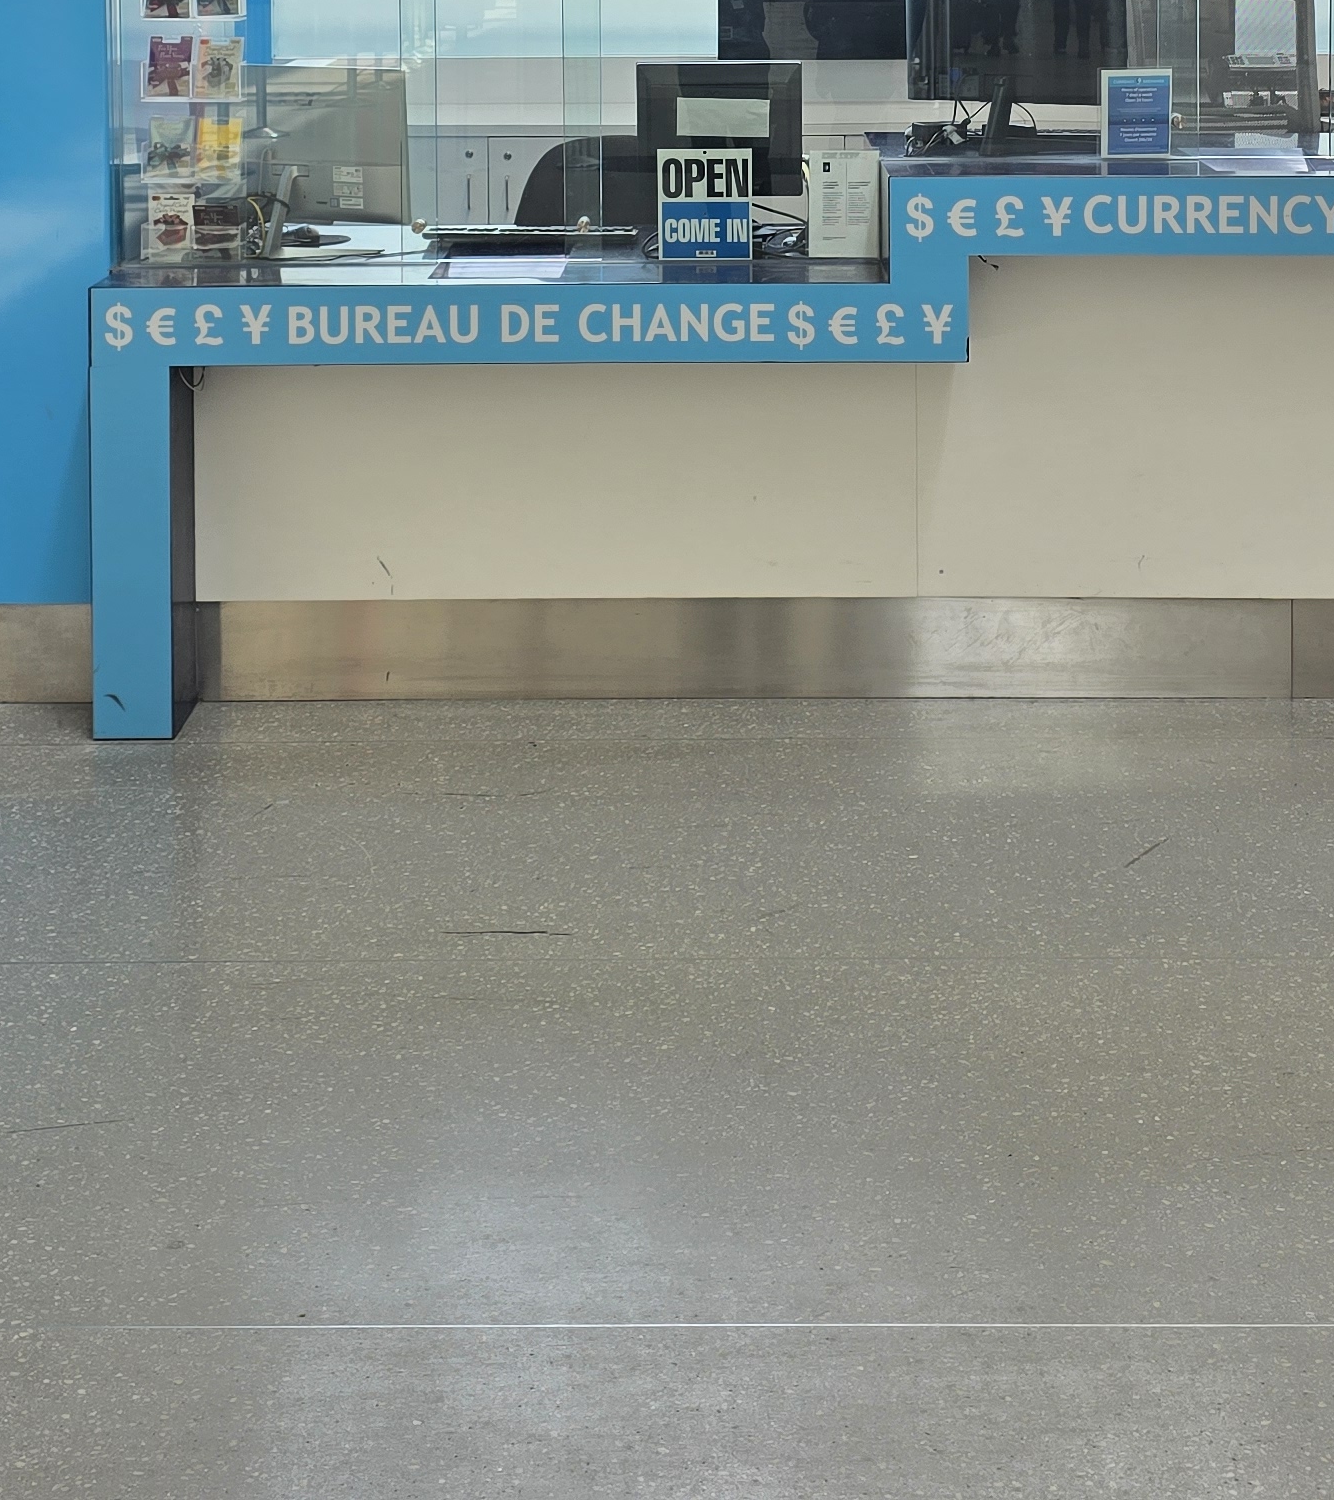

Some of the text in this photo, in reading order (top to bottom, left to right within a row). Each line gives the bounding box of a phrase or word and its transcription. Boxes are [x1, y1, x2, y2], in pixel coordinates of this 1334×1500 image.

[662, 157, 749, 199] OPEN
[664, 218, 748, 243] COME IN
[905, 193, 936, 242] $
[946, 197, 978, 239] €
[994, 194, 1025, 239] £
[1040, 195, 1073, 238] ¥
[103, 301, 954, 351] $ € £ ¥ BUREAU DE CHANGE $ € £ ¥
